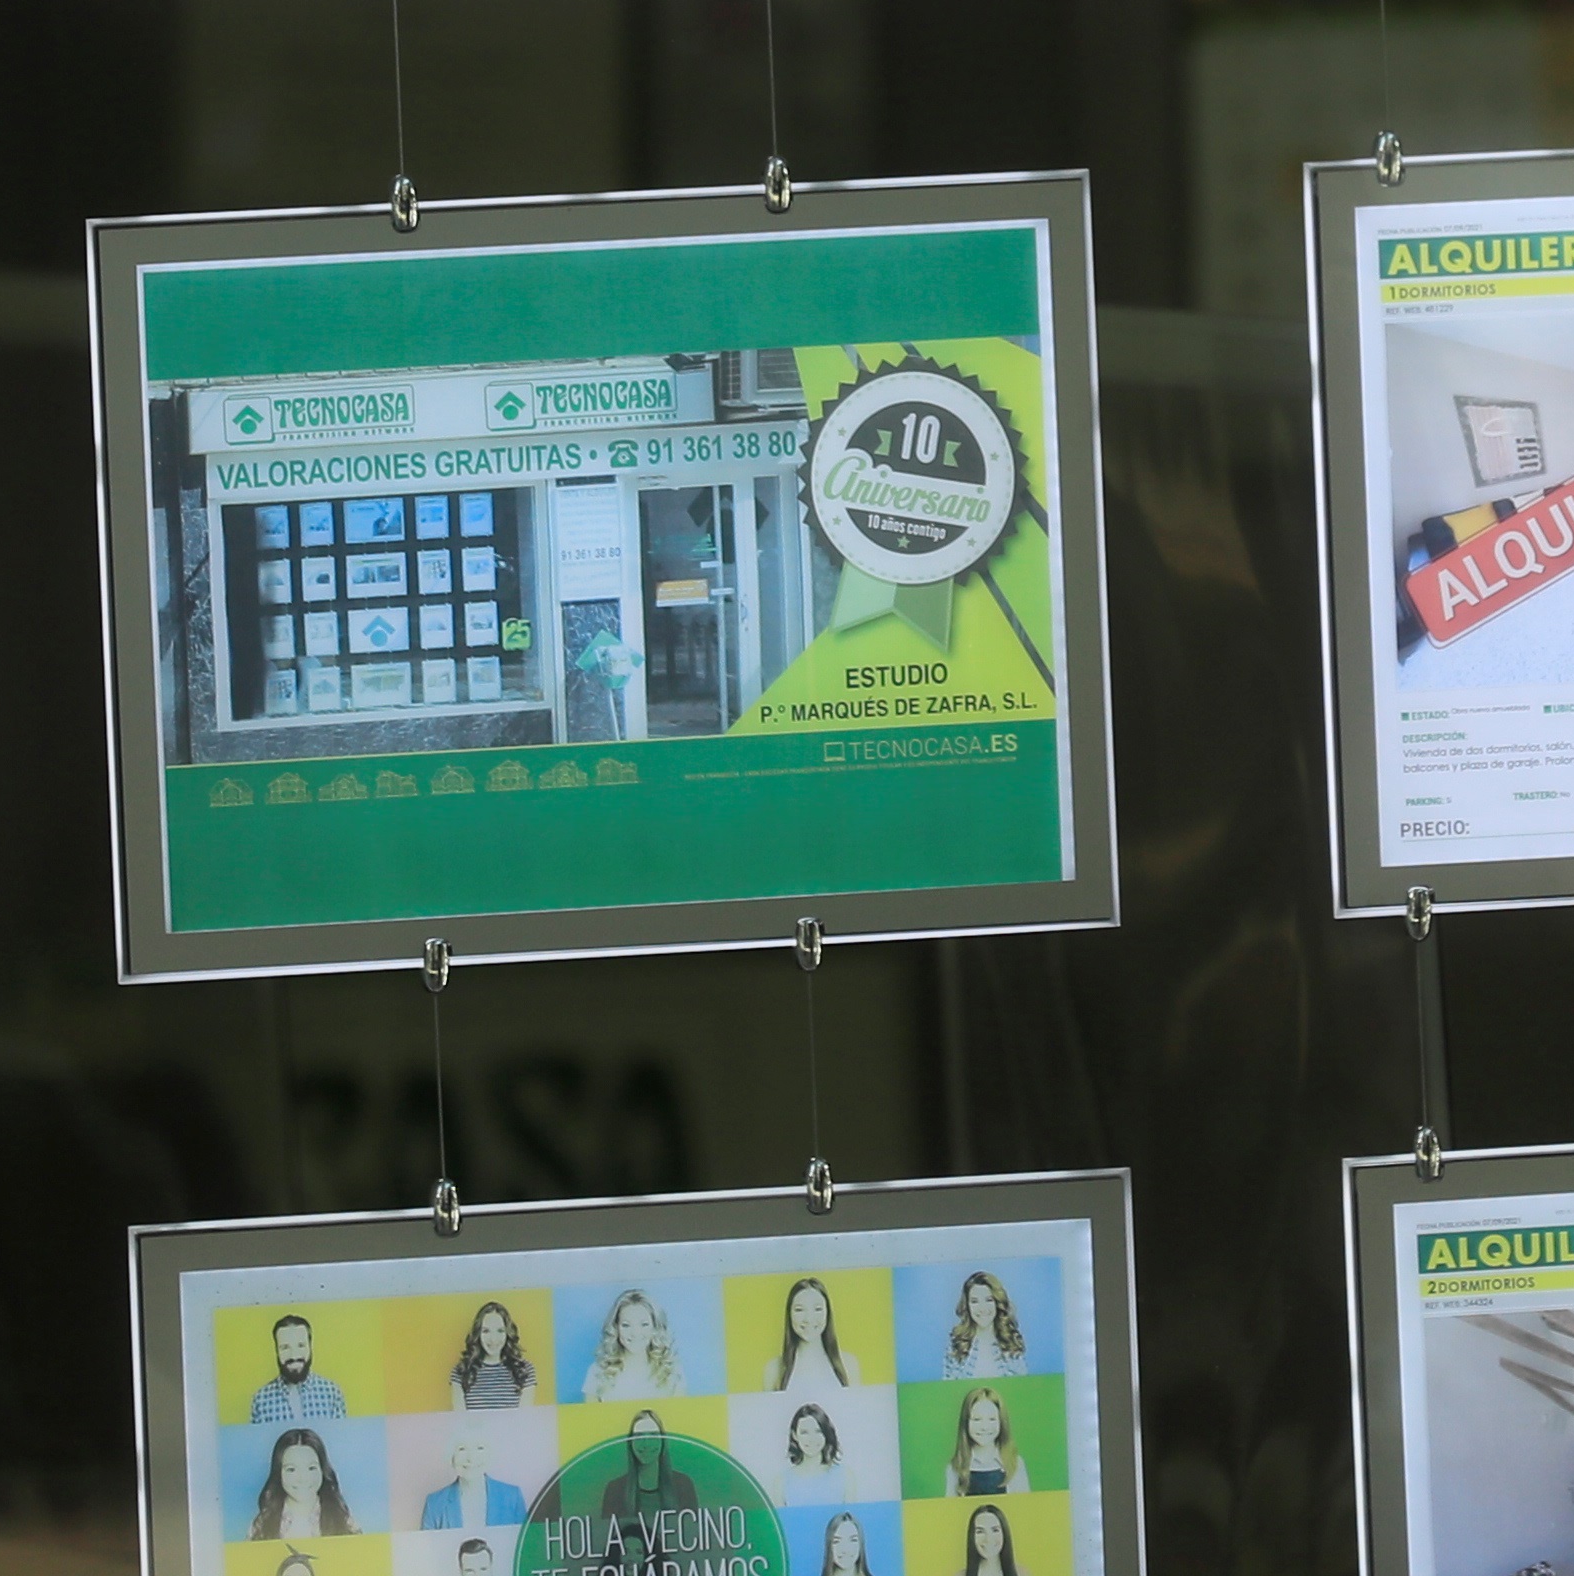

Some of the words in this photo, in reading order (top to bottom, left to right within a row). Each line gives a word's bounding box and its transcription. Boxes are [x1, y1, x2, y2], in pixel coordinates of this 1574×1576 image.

[274, 393, 409, 428] TECNOCASA
[536, 379, 672, 414] TECNOCASA
[901, 412, 940, 463] 10
[217, 452, 427, 491] VALORACIONES
[434, 443, 582, 478] GRATUITAS
[647, 437, 675, 467] 91
[683, 434, 722, 461] 361
[733, 432, 760, 458] 38
[768, 430, 796, 462] 80
[845, 663, 949, 688] ESTUDIO
[790, 696, 888, 721] MARQUÉS
[895, 697, 920, 715] DE
[927, 694, 1000, 713] ZAFRA,
[1003, 692, 1038, 710] S.L.
[848, 733, 1018, 760] TECNOCASA.ES
[1400, 820, 1471, 837] PRECIO:
[545, 1513, 626, 1561] HOLA
